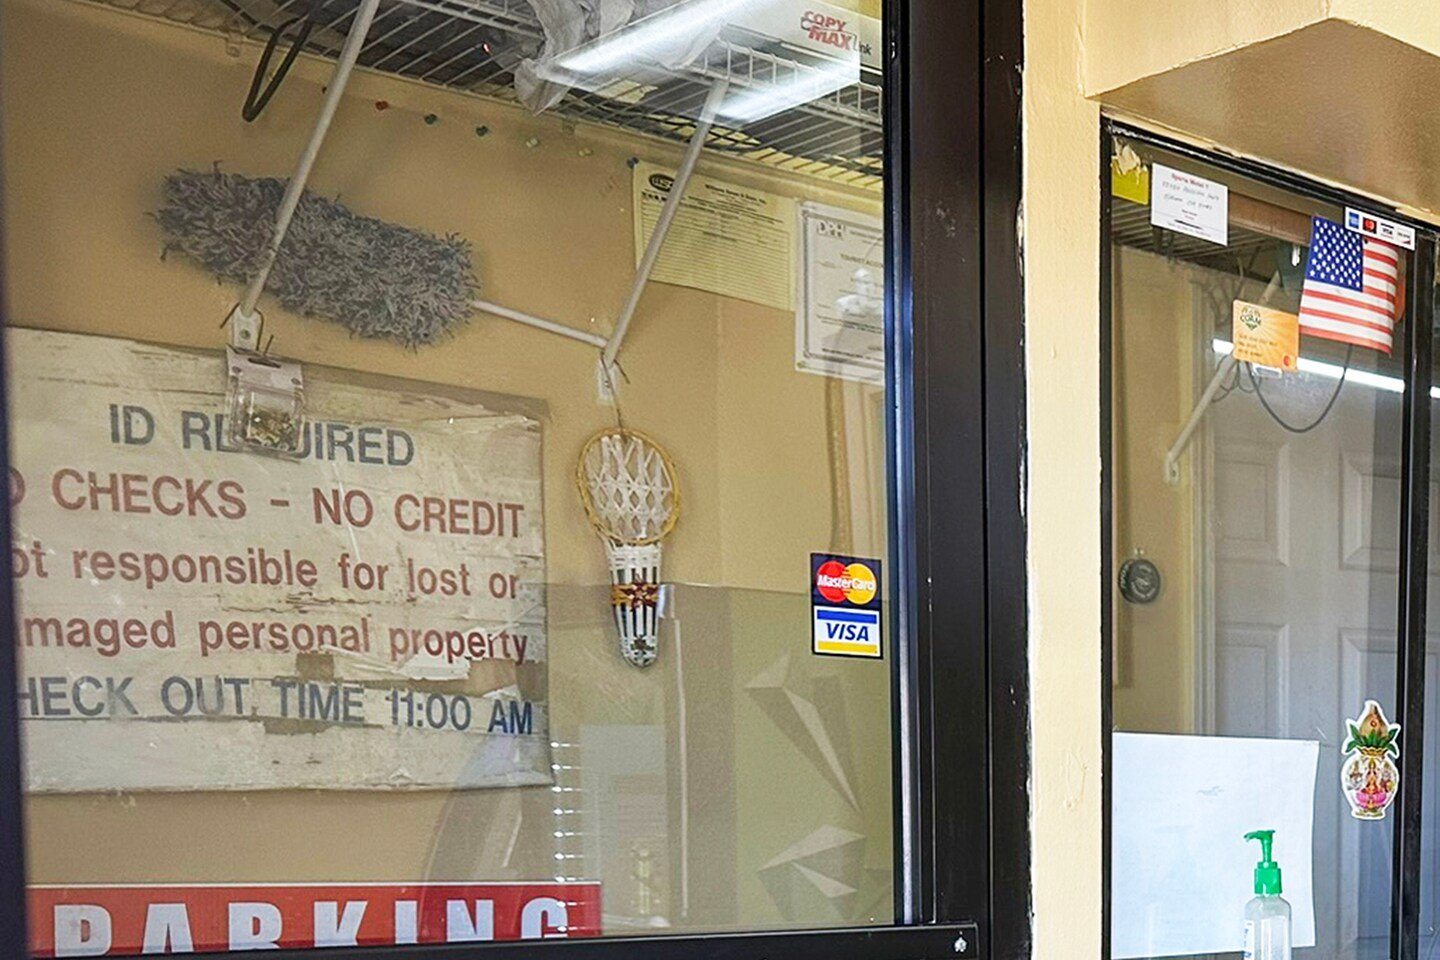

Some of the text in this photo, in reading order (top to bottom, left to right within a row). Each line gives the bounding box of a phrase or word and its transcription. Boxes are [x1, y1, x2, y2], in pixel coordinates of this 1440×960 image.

[109, 403, 155, 446] ID
[52, 468, 247, 520] CHECKS
[312, 487, 374, 528] NO
[394, 493, 525, 538] CREDIT
[13, 540, 521, 600] ot responsible for lost or
[17, 610, 529, 666] maged personal property
[825, 622, 870, 642] VISA
[18, 674, 533, 735] HECK OUT TIME 11:00 AM
